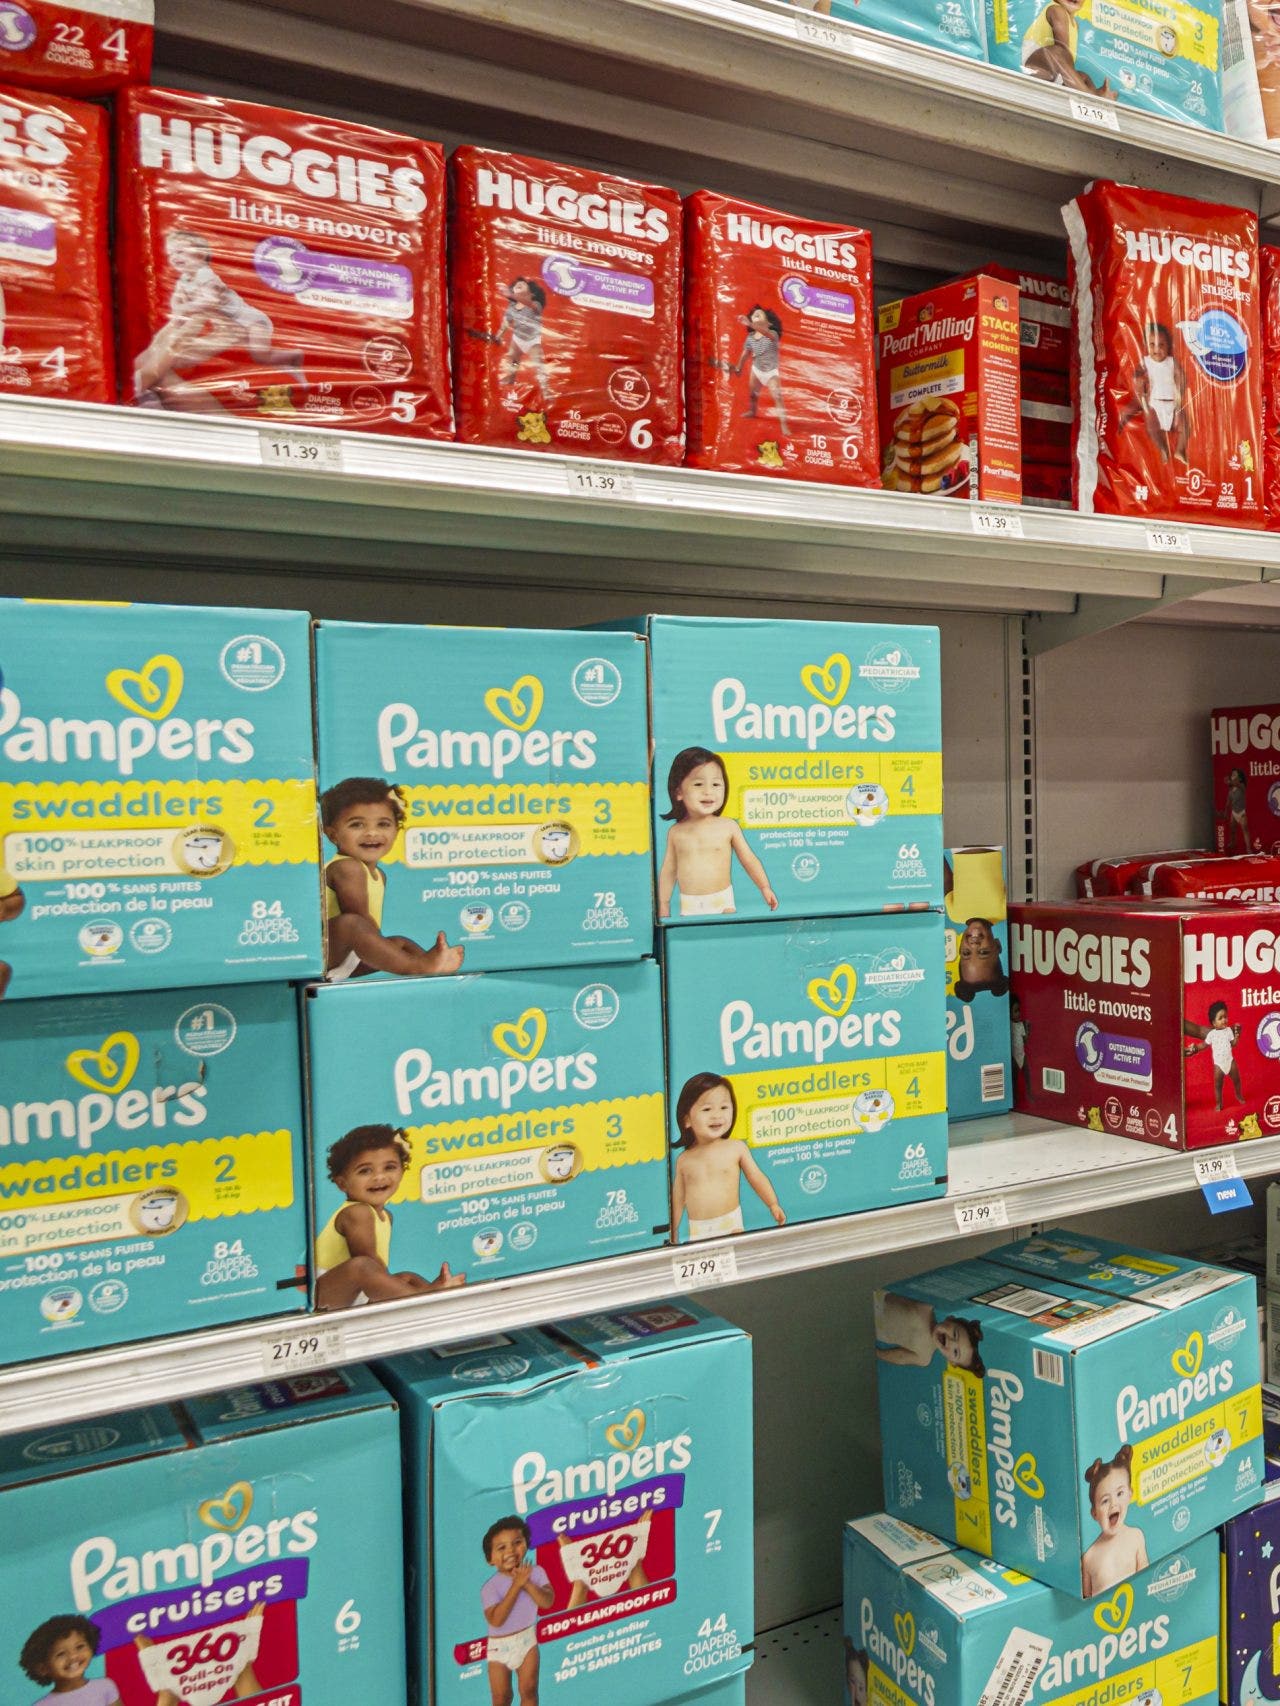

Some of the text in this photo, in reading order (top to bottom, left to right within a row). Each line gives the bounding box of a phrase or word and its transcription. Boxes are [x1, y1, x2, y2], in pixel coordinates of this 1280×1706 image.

[946, 2, 962, 17] 22
[54, 22, 85, 43] 22
[1195, 22, 1203, 40] 3
[102, 29, 129, 62] 4
[1191, 81, 1202, 94] 26
[138, 112, 427, 214] HUGGIES
[477, 170, 669, 243] HUGGIES
[228, 198, 412, 248] little movers
[537, 228, 654, 266] little movers
[727, 212, 858, 269] HUGGIES
[1125, 230, 1250, 280] HUGGIES
[327, 264, 408, 282] OUTSTANDING
[781, 257, 859, 284] little movers
[595, 274, 646, 292] OUTSTANDING
[881, 315, 977, 358] Pearl Milling
[982, 316, 1018, 333] STACK
[40, 346, 67, 377] 4
[317, 382, 333, 394] 19
[908, 383, 942, 398] COMPLETE
[390, 391, 427, 423] 5
[569, 410, 581, 420] 16
[630, 419, 653, 449] 6
[272, 443, 319, 460] 11.39
[841, 435, 859, 460] 6
[577, 474, 615, 490] 11.39
[978, 515, 1006, 529] 11.39
[1152, 534, 1177, 545] 11.39
[236, 642, 261, 664] #1
[585, 665, 604, 682] #1
[863, 667, 917, 678] PEDIATRICIAN
[711, 678, 896, 751] Pampers
[378, 703, 597, 779] Pampers
[749, 760, 864, 780] swaddlers
[1250, 760, 1278, 777] little
[900, 775, 914, 797] 4
[12, 791, 224, 820] swaddlers
[252, 799, 276, 828] 2
[411, 794, 572, 817] swaddlers
[594, 798, 612, 825] 3
[15, 854, 165, 873] skin protection
[252, 901, 282, 917] 84
[594, 893, 616, 908] 78
[239, 929, 299, 945] COUCHES
[245, 918, 292, 932] DIAPERS
[1011, 923, 1151, 988] HUGGIES
[868, 971, 921, 983] PEDIATRICIAN
[719, 1000, 901, 1065] Pampers
[394, 1048, 598, 1115] Pampers
[757, 1071, 871, 1100] swaddlers
[906, 1077, 921, 1098] 4
[426, 1117, 574, 1154] swaddlers
[606, 1114, 623, 1138] 3
[1164, 1113, 1178, 1142] 4
[904, 1144, 925, 1158] 66
[213, 1154, 236, 1183] 2
[474, 1156, 531, 1173] LEAKPROOF
[899, 1167, 932, 1180] COUCHES
[1200, 1161, 1223, 1174] 31.99
[0, 1157, 178, 1199] waddlers
[428, 1169, 534, 1196] skin protection
[607, 1190, 627, 1205] 78
[961, 1208, 990, 1222] 27.99
[25, 1220, 122, 1247] protection
[681, 1260, 716, 1278] 27.99
[1209, 1323, 1246, 1344] PEDIATRICIAN
[273, 1338, 319, 1360] 27.99
[1116, 1359, 1233, 1442] Pampers
[967, 1387, 982, 1487] swaddlers
[988, 1368, 1025, 1529] Pampers
[1142, 1417, 1215, 1464] swaddlers
[512, 1434, 692, 1514] Pampers
[552, 1487, 666, 1533] cruisers
[71, 1510, 318, 1612] Pampers
[1148, 1569, 1195, 1594] PEDIATRICIAN
[127, 1574, 283, 1634] cruisers
[334, 1599, 362, 1634] 6
[697, 1614, 728, 1637] 44
[684, 1643, 741, 1675] COUCHES
[861, 1597, 935, 1706] Pampers
[179, 1662, 234, 1685] Pull-On
[182, 1675, 232, 1696] Diaper
